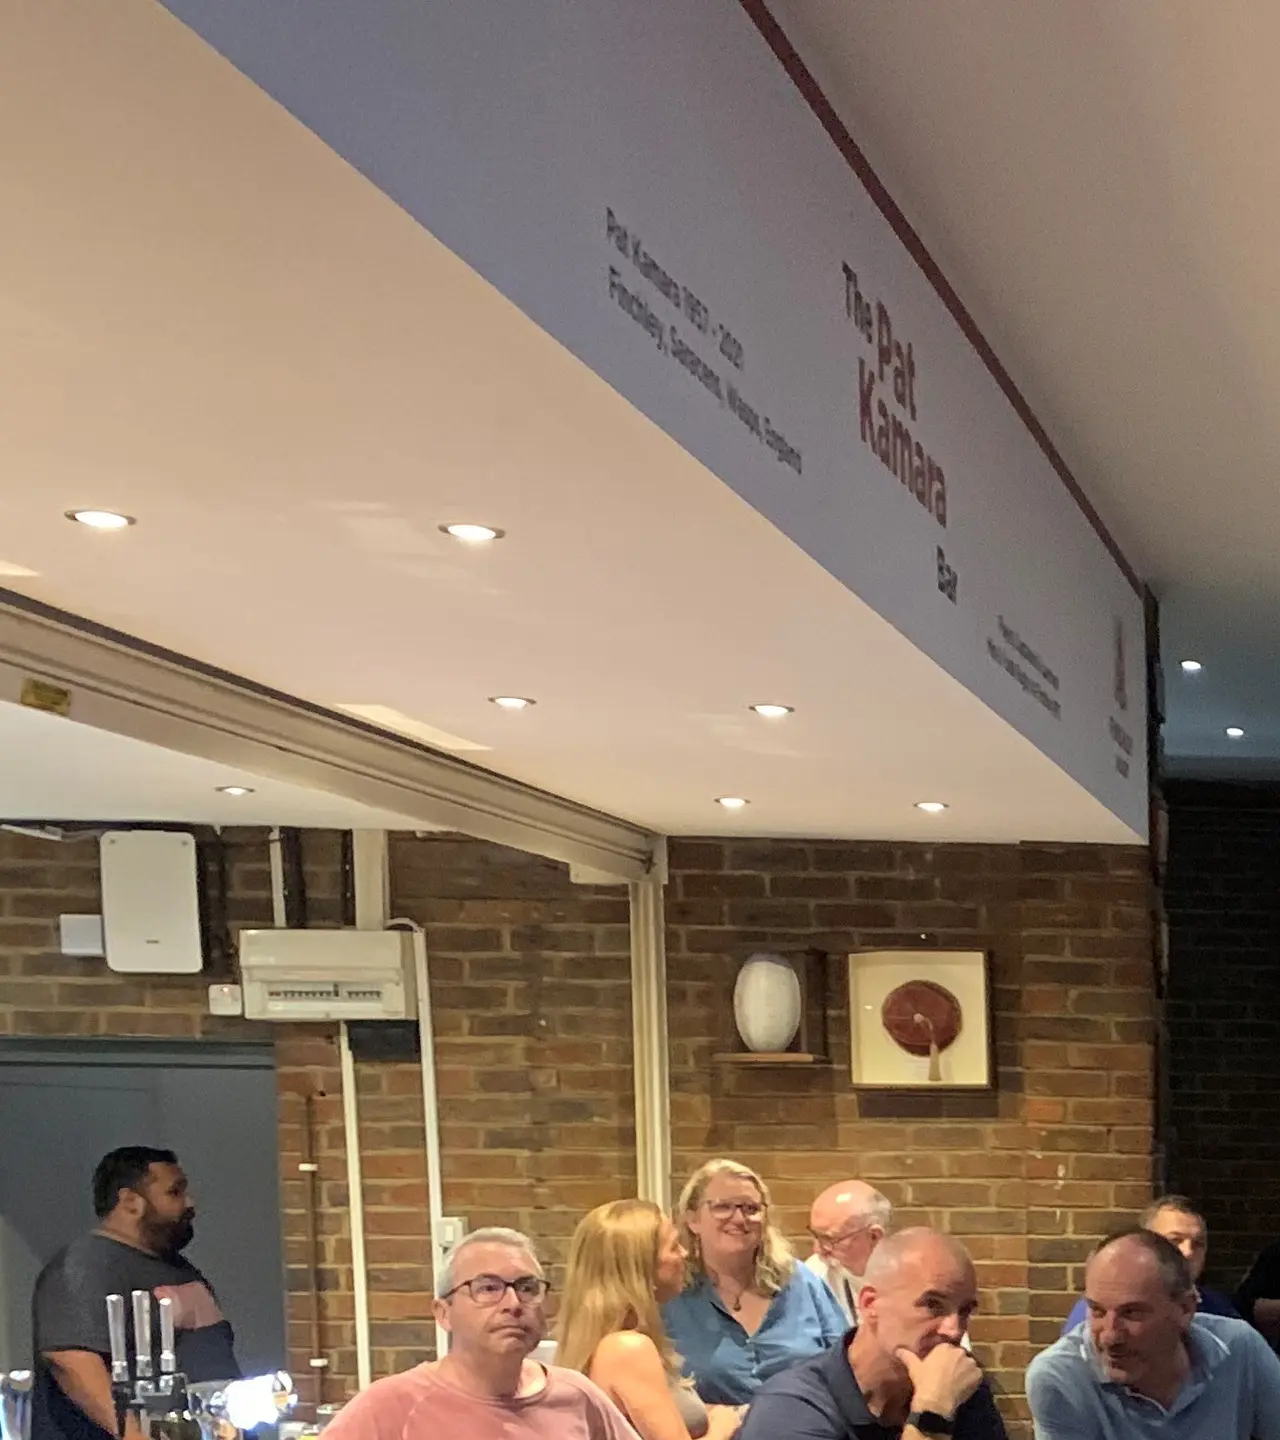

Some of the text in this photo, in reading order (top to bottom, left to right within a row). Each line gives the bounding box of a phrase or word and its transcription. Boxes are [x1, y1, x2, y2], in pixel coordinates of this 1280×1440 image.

[842, 260, 872, 344] The
[876, 299, 917, 422] Pat
[857, 356, 947, 530] Kamara
